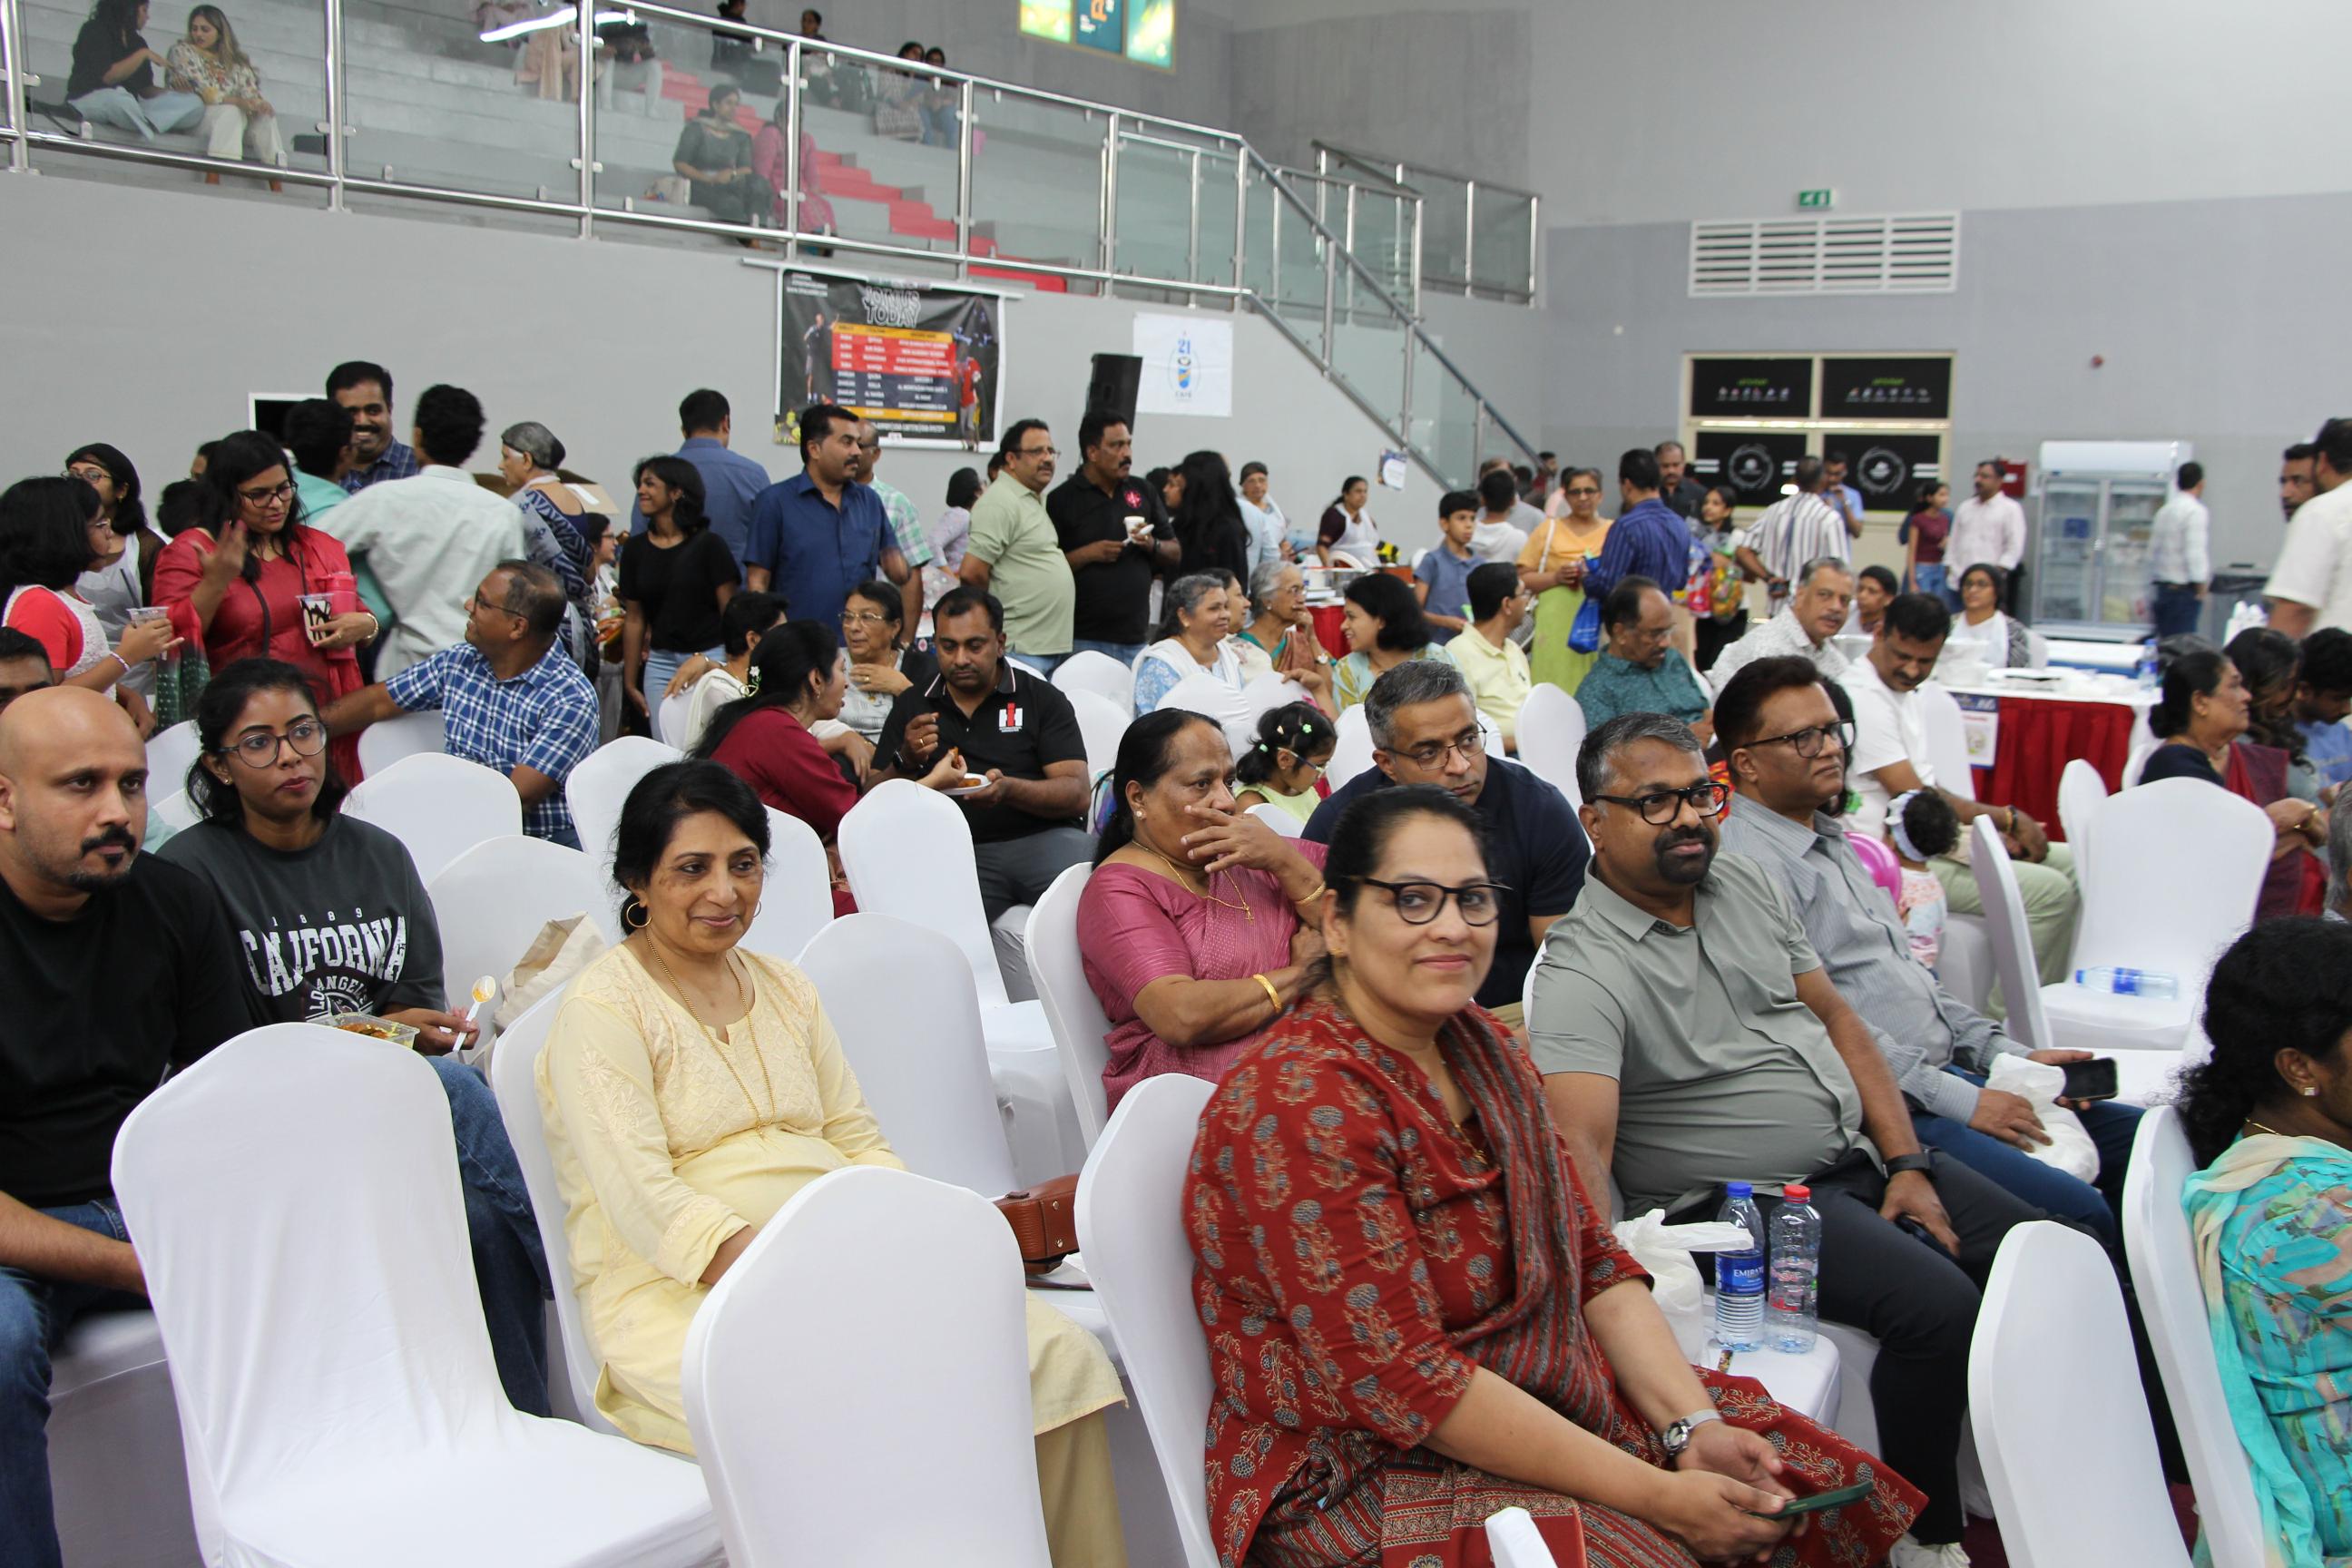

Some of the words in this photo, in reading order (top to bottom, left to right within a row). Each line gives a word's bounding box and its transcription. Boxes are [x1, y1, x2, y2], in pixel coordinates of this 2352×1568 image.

[865, 305, 920, 328] TODAY
[1178, 338, 1191, 355] 21
[271, 907, 363, 926] 1889
[317, 975, 368, 1005] ANGEL
